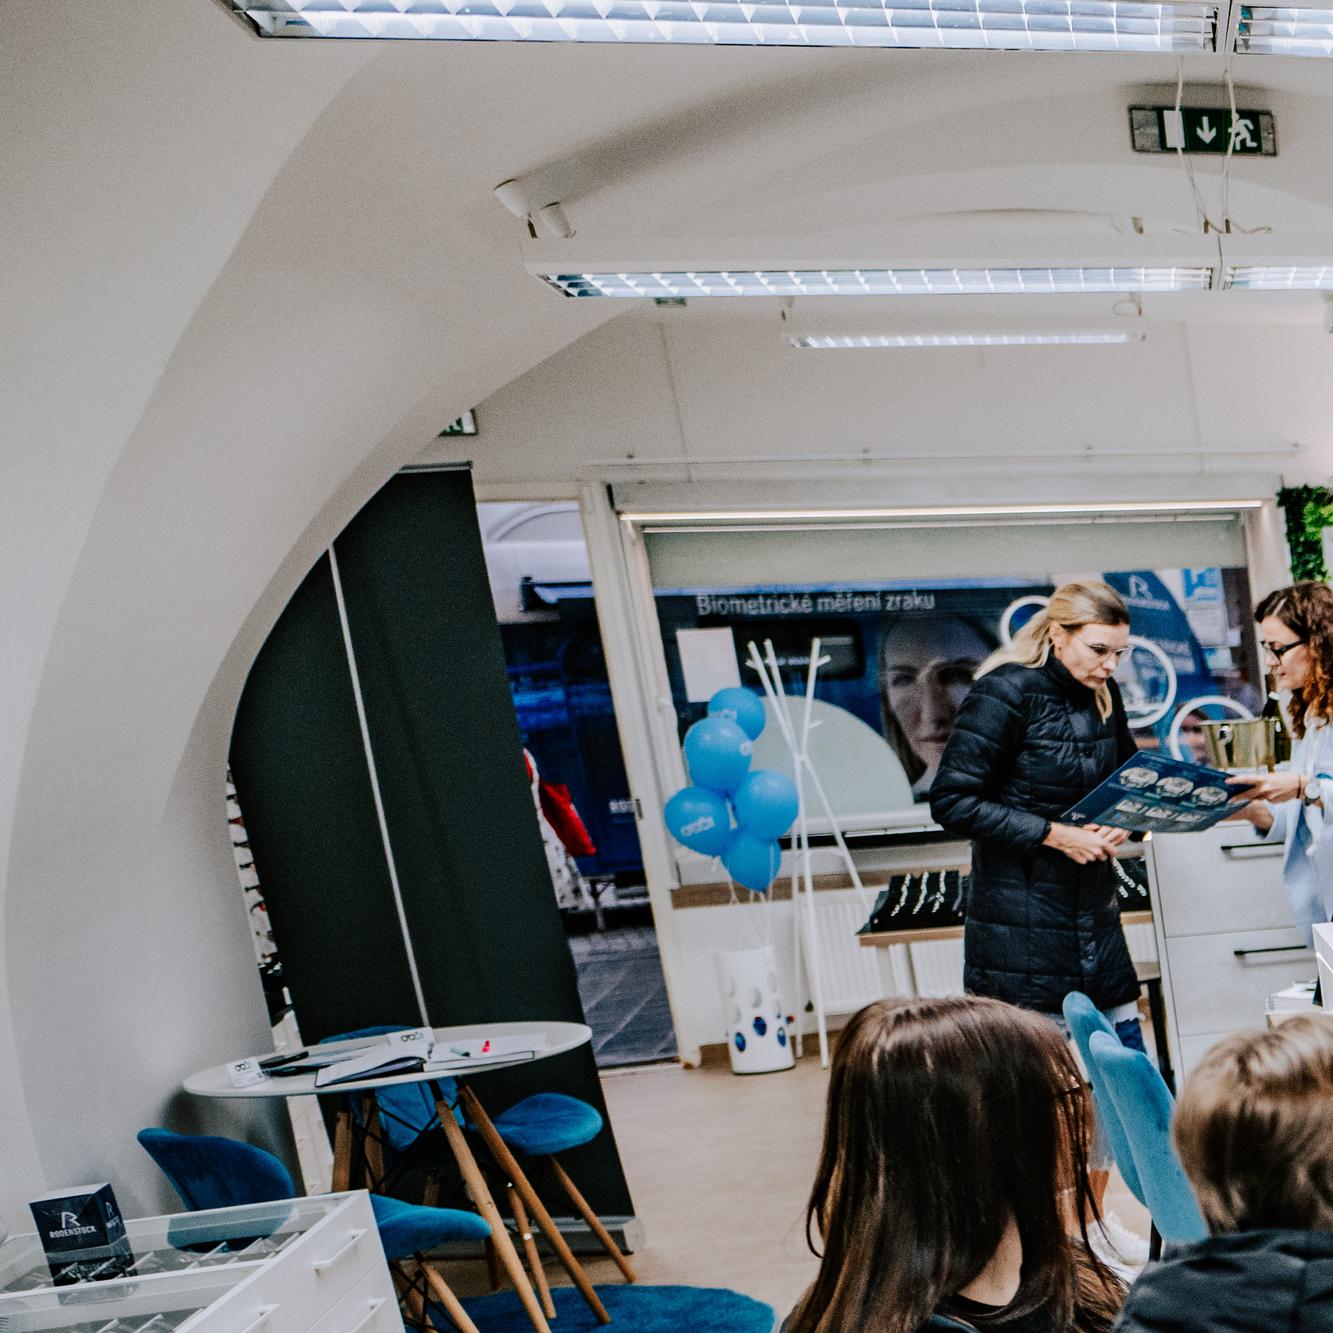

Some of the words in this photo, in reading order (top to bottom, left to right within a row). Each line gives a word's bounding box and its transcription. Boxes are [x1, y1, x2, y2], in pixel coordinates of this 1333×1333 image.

[696, 594, 813, 616] Biometrické
[817, 591, 881, 612] měření
[885, 589, 936, 610] zraku
[49, 1225, 97, 1239] RODENSTOCK
